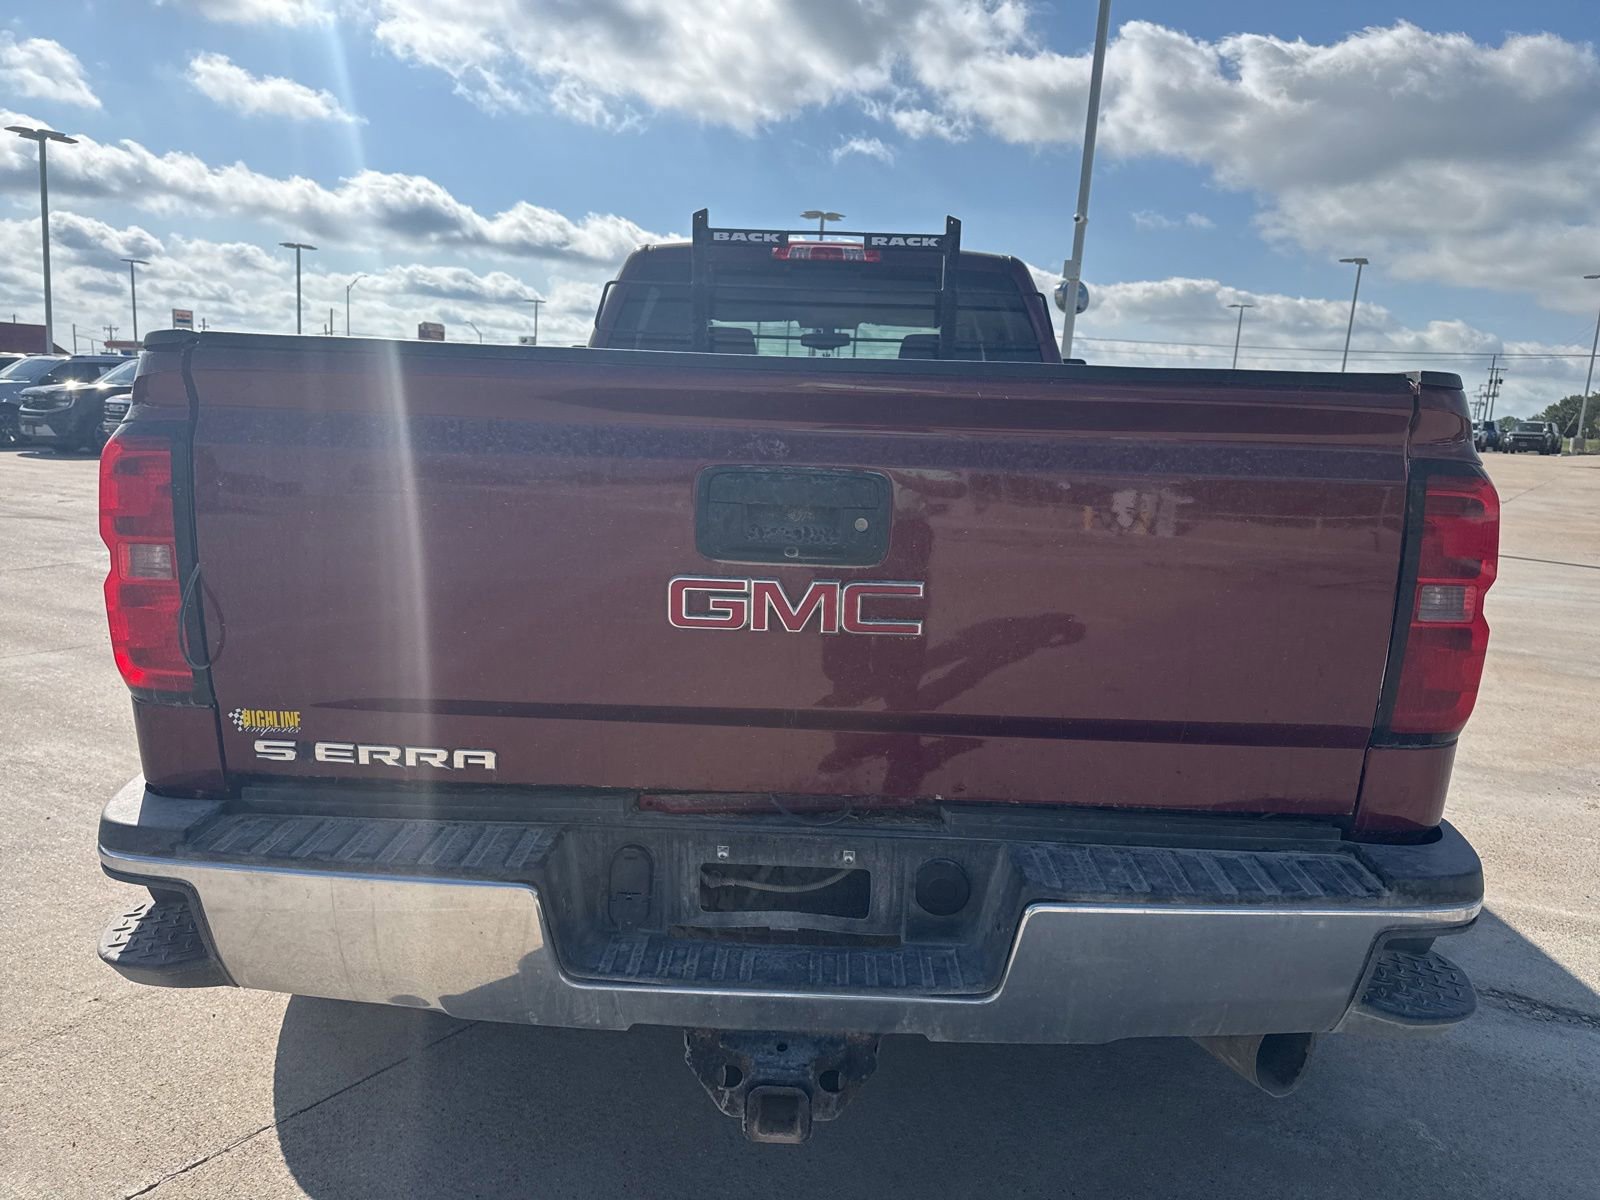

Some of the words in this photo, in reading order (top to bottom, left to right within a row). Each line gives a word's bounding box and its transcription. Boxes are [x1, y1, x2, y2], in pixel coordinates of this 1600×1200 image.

[713, 232, 780, 243] BACK
[871, 237, 938, 247] RACK
[668, 577, 925, 635] GMC
